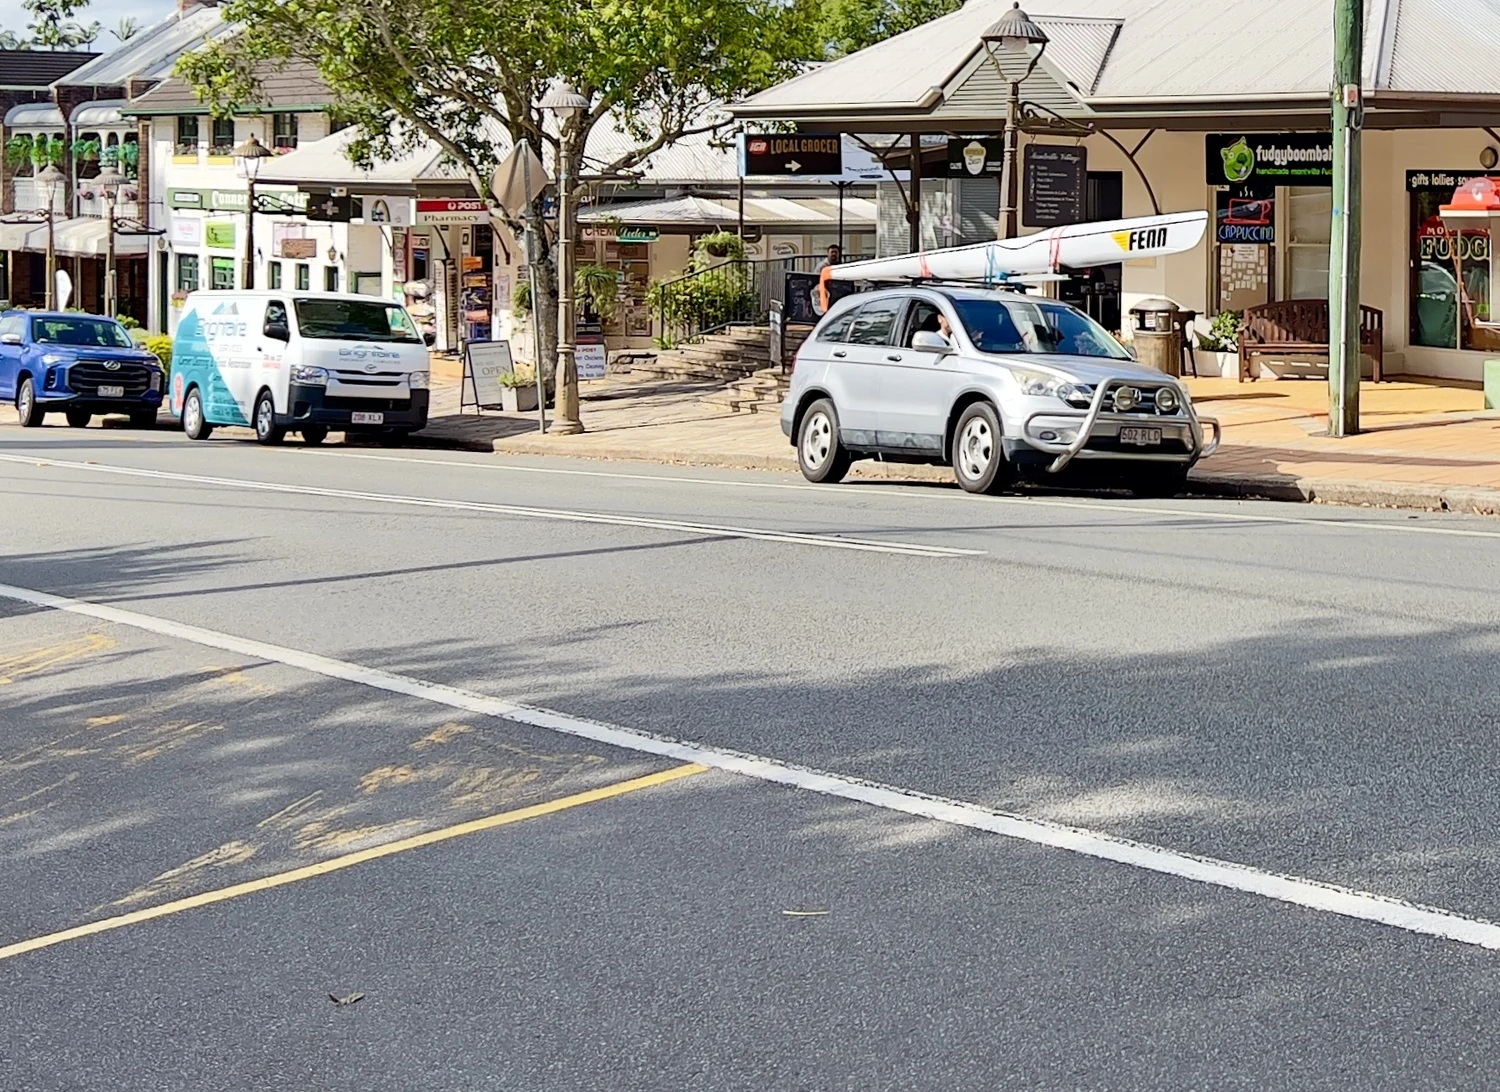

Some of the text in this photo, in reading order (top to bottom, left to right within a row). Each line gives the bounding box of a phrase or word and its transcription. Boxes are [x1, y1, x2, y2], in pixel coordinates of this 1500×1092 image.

[770, 139, 800, 155] LOCAL
[801, 138, 838, 154] GROCER
[1256, 144, 1333, 166] fudgyboombah
[1412, 173, 1429, 188] gifts
[1431, 173, 1455, 186] lollies
[457, 201, 482, 210] POST
[423, 214, 480, 224] Pharmacy
[1128, 227, 1168, 251] FENN
[1218, 224, 1274, 242] CAPPUCCINO
[1420, 235, 1490, 261] FUDG
[481, 365, 510, 377] OPEN
